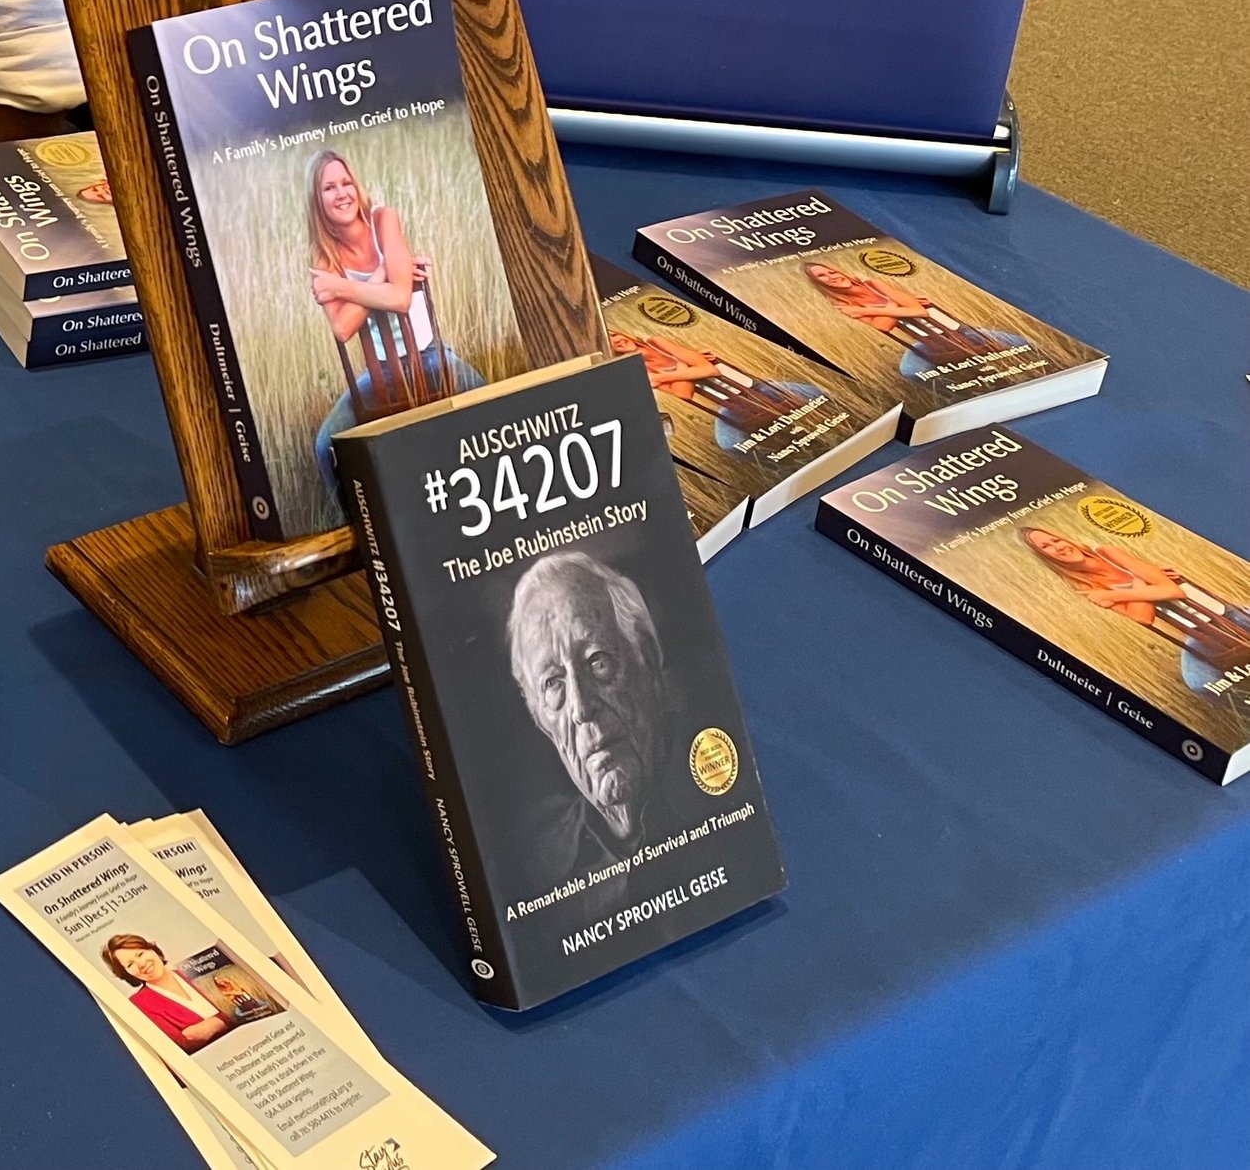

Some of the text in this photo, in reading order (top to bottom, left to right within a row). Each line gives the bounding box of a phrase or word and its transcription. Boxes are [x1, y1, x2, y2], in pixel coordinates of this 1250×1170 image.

[183, 33, 246, 76] On
[257, 57, 376, 110] Wings
[146, 75, 202, 268] On Shattered Wings
[213, 97, 446, 166] A Family's Journey from Grief to Hope
[209, 322, 251, 463] Dultmeier Geise
[460, 403, 583, 464] AUSCHWITZ
[424, 419, 622, 537] #34207
[851, 430, 1023, 516] On Shattered
[924, 472, 1019, 519] Wings
[443, 500, 648, 582] The Joe Rubinstein Story
[846, 528, 1154, 730] On Shattered Wings Dultmeier Geise
[353, 479, 484, 953] AUSCHWITZ #34207 The Joe Rubinstein Story NANCY SPROWELL GEISE
[698, 755, 730, 775] WINNER
[25, 841, 113, 897] ATTEND IN PERSON!
[44, 904, 56, 915] On
[57, 880, 102, 909] Shattered
[102, 861, 130, 884] Wings
[507, 802, 755, 921] A Remarkable Journey of Survival and Triumph
[562, 866, 728, 956] NANCY SPROWELL GEISE
